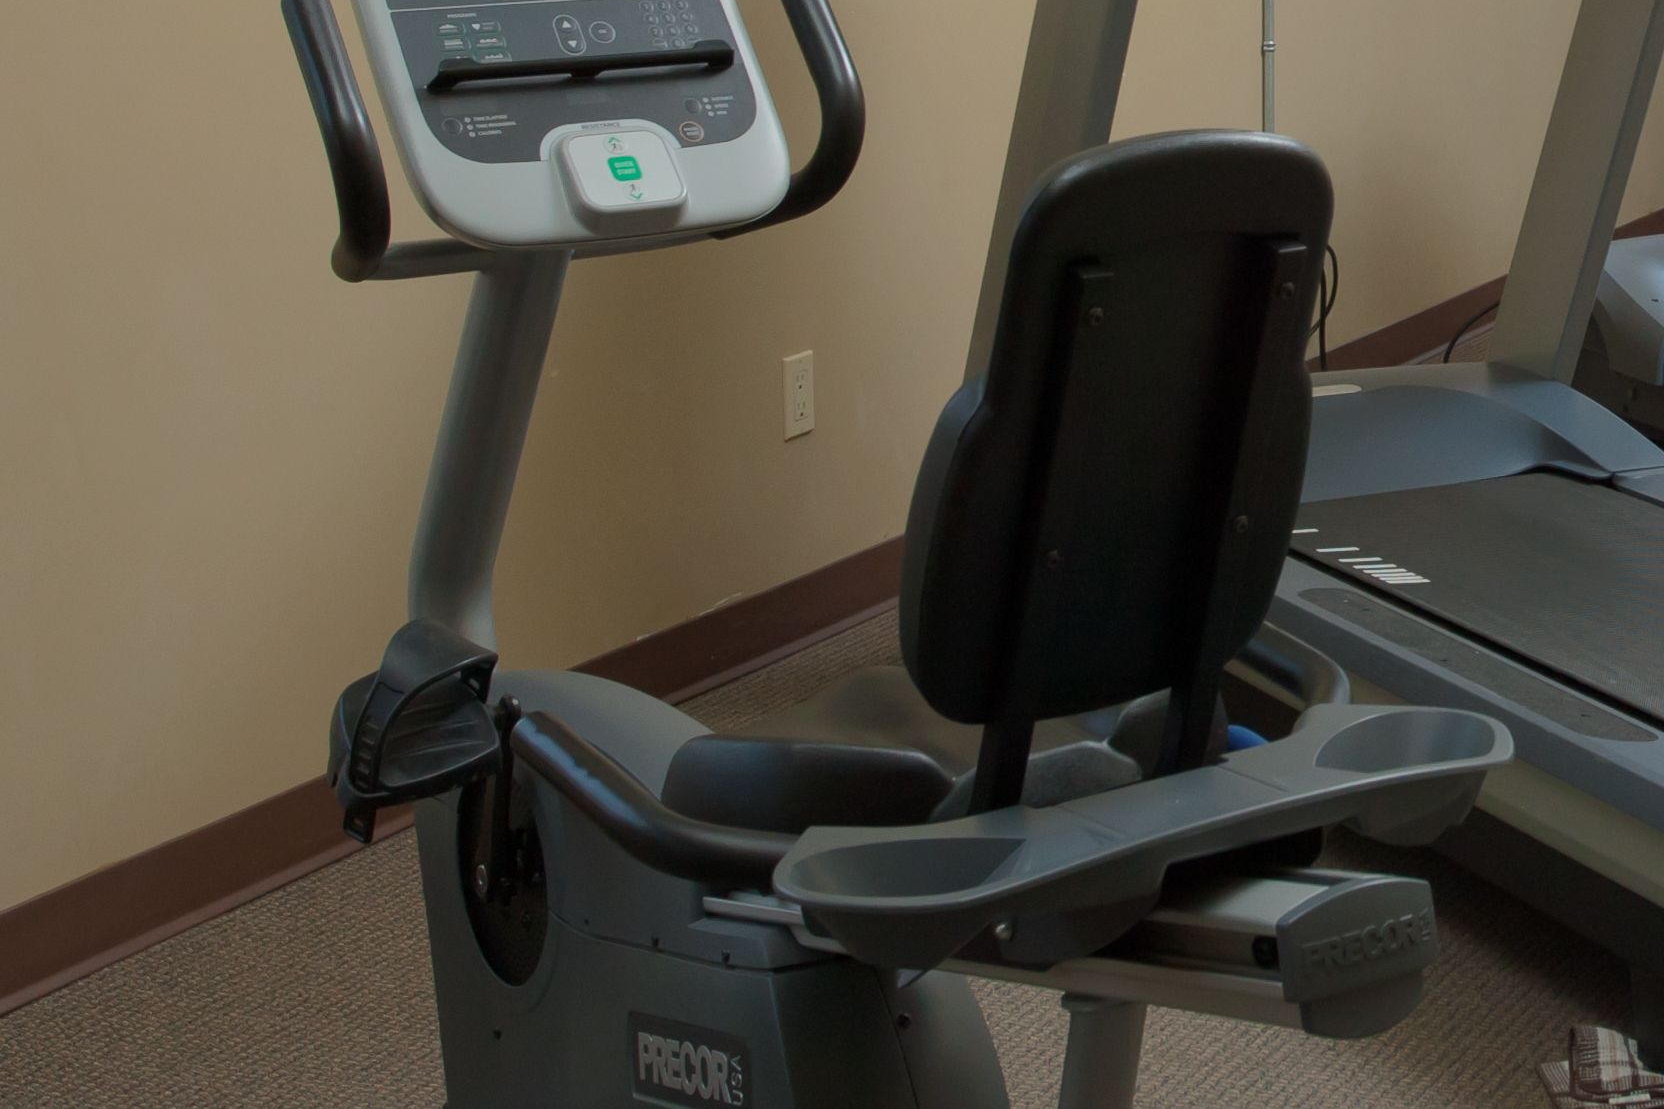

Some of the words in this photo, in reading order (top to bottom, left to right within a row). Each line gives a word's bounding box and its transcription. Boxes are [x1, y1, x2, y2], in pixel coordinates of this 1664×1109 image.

[1301, 914, 1415, 974] PRECOR
[637, 1031, 732, 1105] PRECOR
[730, 1054, 744, 1106] USA
